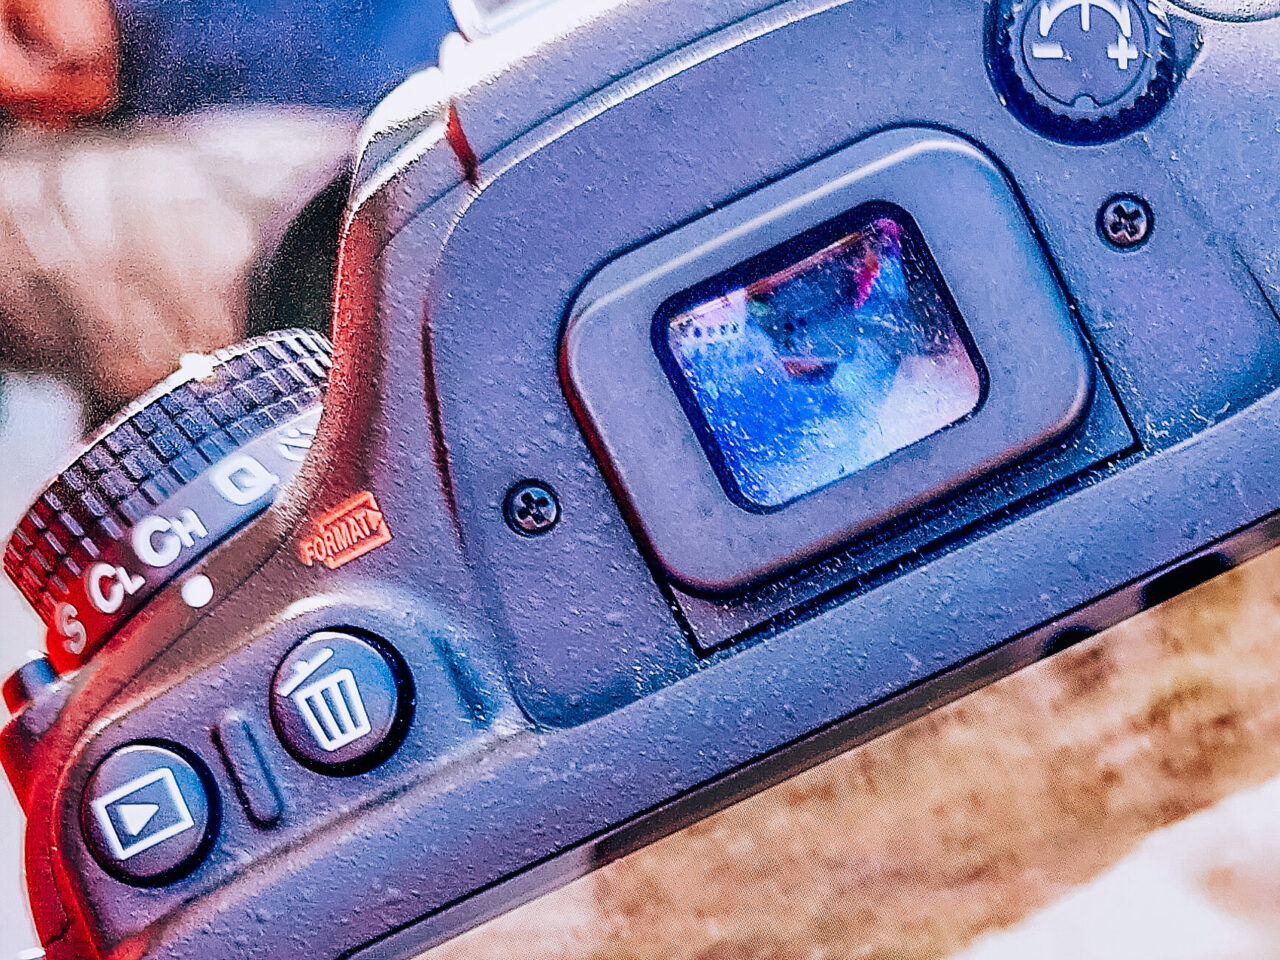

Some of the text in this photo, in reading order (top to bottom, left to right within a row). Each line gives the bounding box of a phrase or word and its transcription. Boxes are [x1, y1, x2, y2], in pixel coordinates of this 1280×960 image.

[212, 455, 279, 504] Q
[302, 510, 380, 565] FORMAT
[54, 604, 88, 655] S
